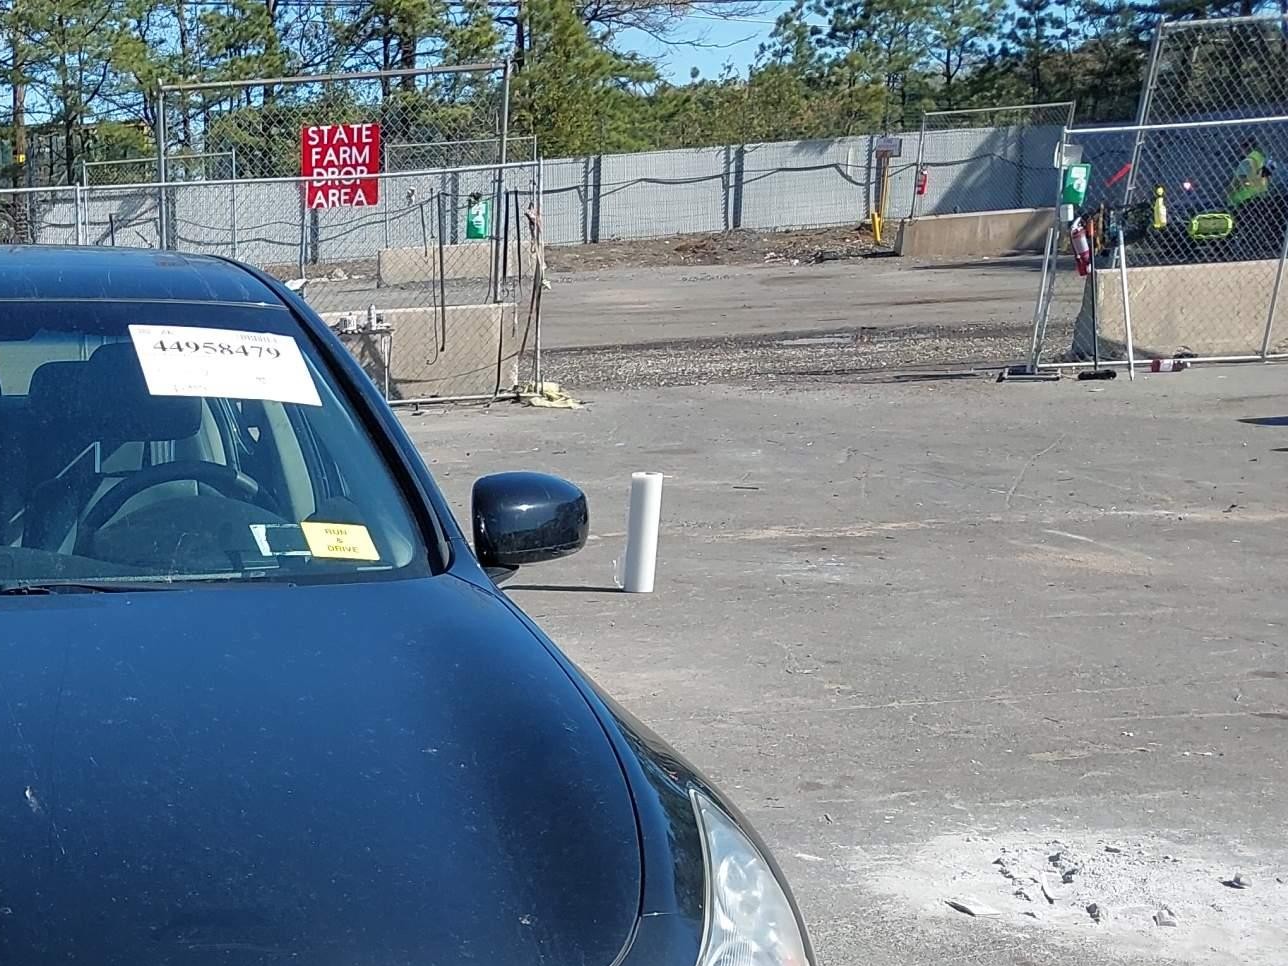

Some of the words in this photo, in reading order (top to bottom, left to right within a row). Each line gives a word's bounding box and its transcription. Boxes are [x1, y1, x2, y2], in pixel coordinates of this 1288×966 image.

[307, 123, 373, 145] STATE
[311, 145, 370, 167] FARM
[312, 166, 368, 187] DROP
[312, 188, 367, 209] AREA
[152, 340, 281, 359] 44958479
[324, 528, 348, 536] RUN
[327, 544, 360, 553] DRIVE
